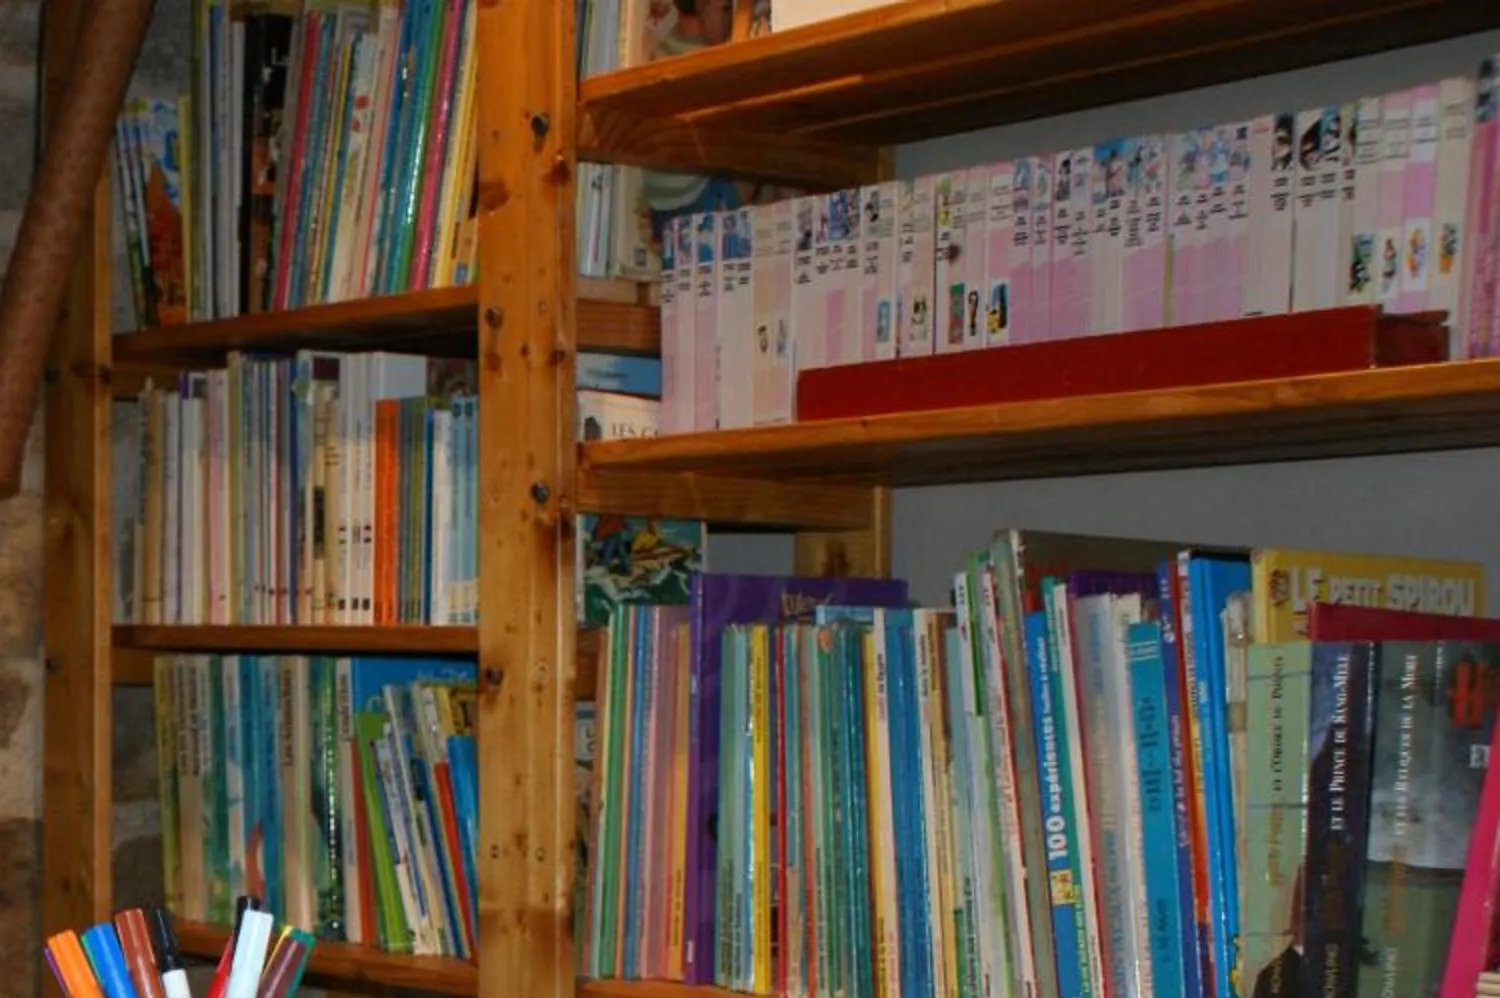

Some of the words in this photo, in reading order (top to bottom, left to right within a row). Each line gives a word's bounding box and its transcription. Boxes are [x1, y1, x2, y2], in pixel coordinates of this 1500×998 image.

[1291, 567, 1322, 613] LE
[1040, 715, 1064, 814] expériences
[1328, 748, 1348, 793] PRINCE
[1047, 814, 1069, 861] 100
